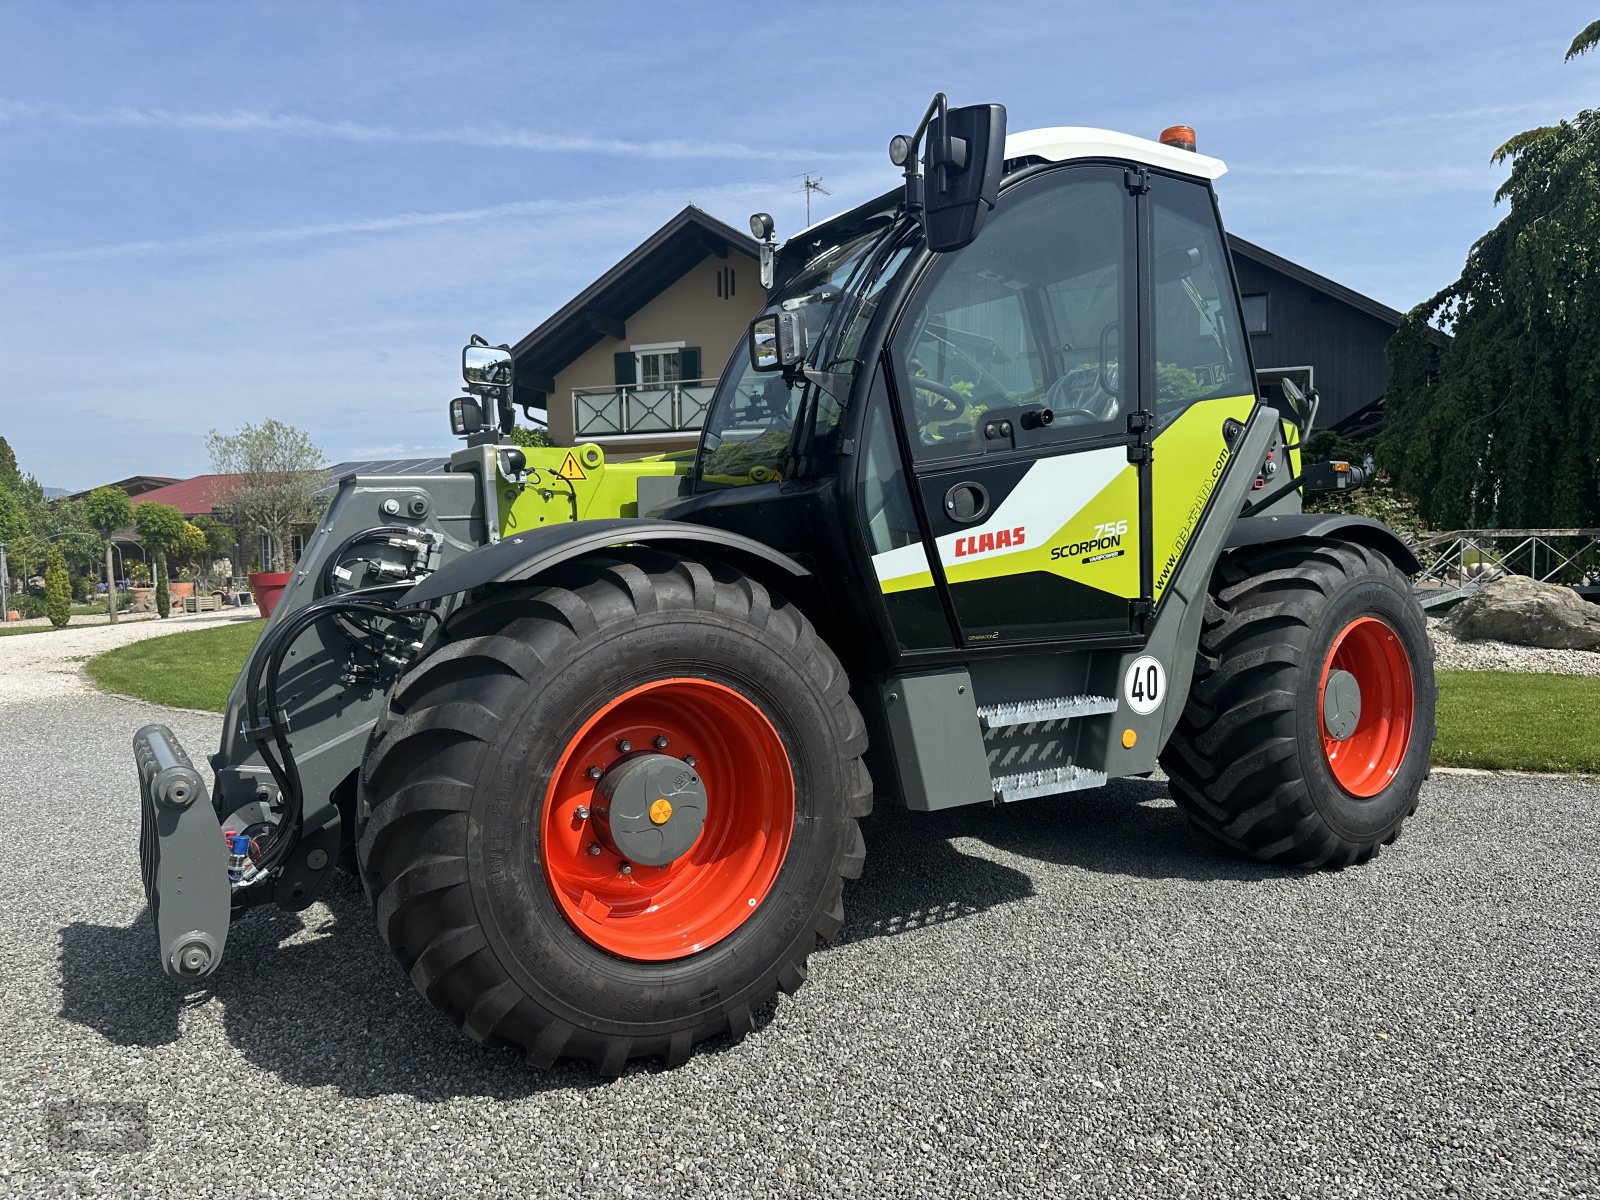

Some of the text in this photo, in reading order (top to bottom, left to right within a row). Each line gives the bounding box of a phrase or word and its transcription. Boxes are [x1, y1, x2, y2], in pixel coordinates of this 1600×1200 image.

[955, 526, 1025, 558] CLAAS
[1094, 519, 1128, 541] 756
[1051, 535, 1121, 561] SCORPION
[1131, 665, 1158, 702] 40
